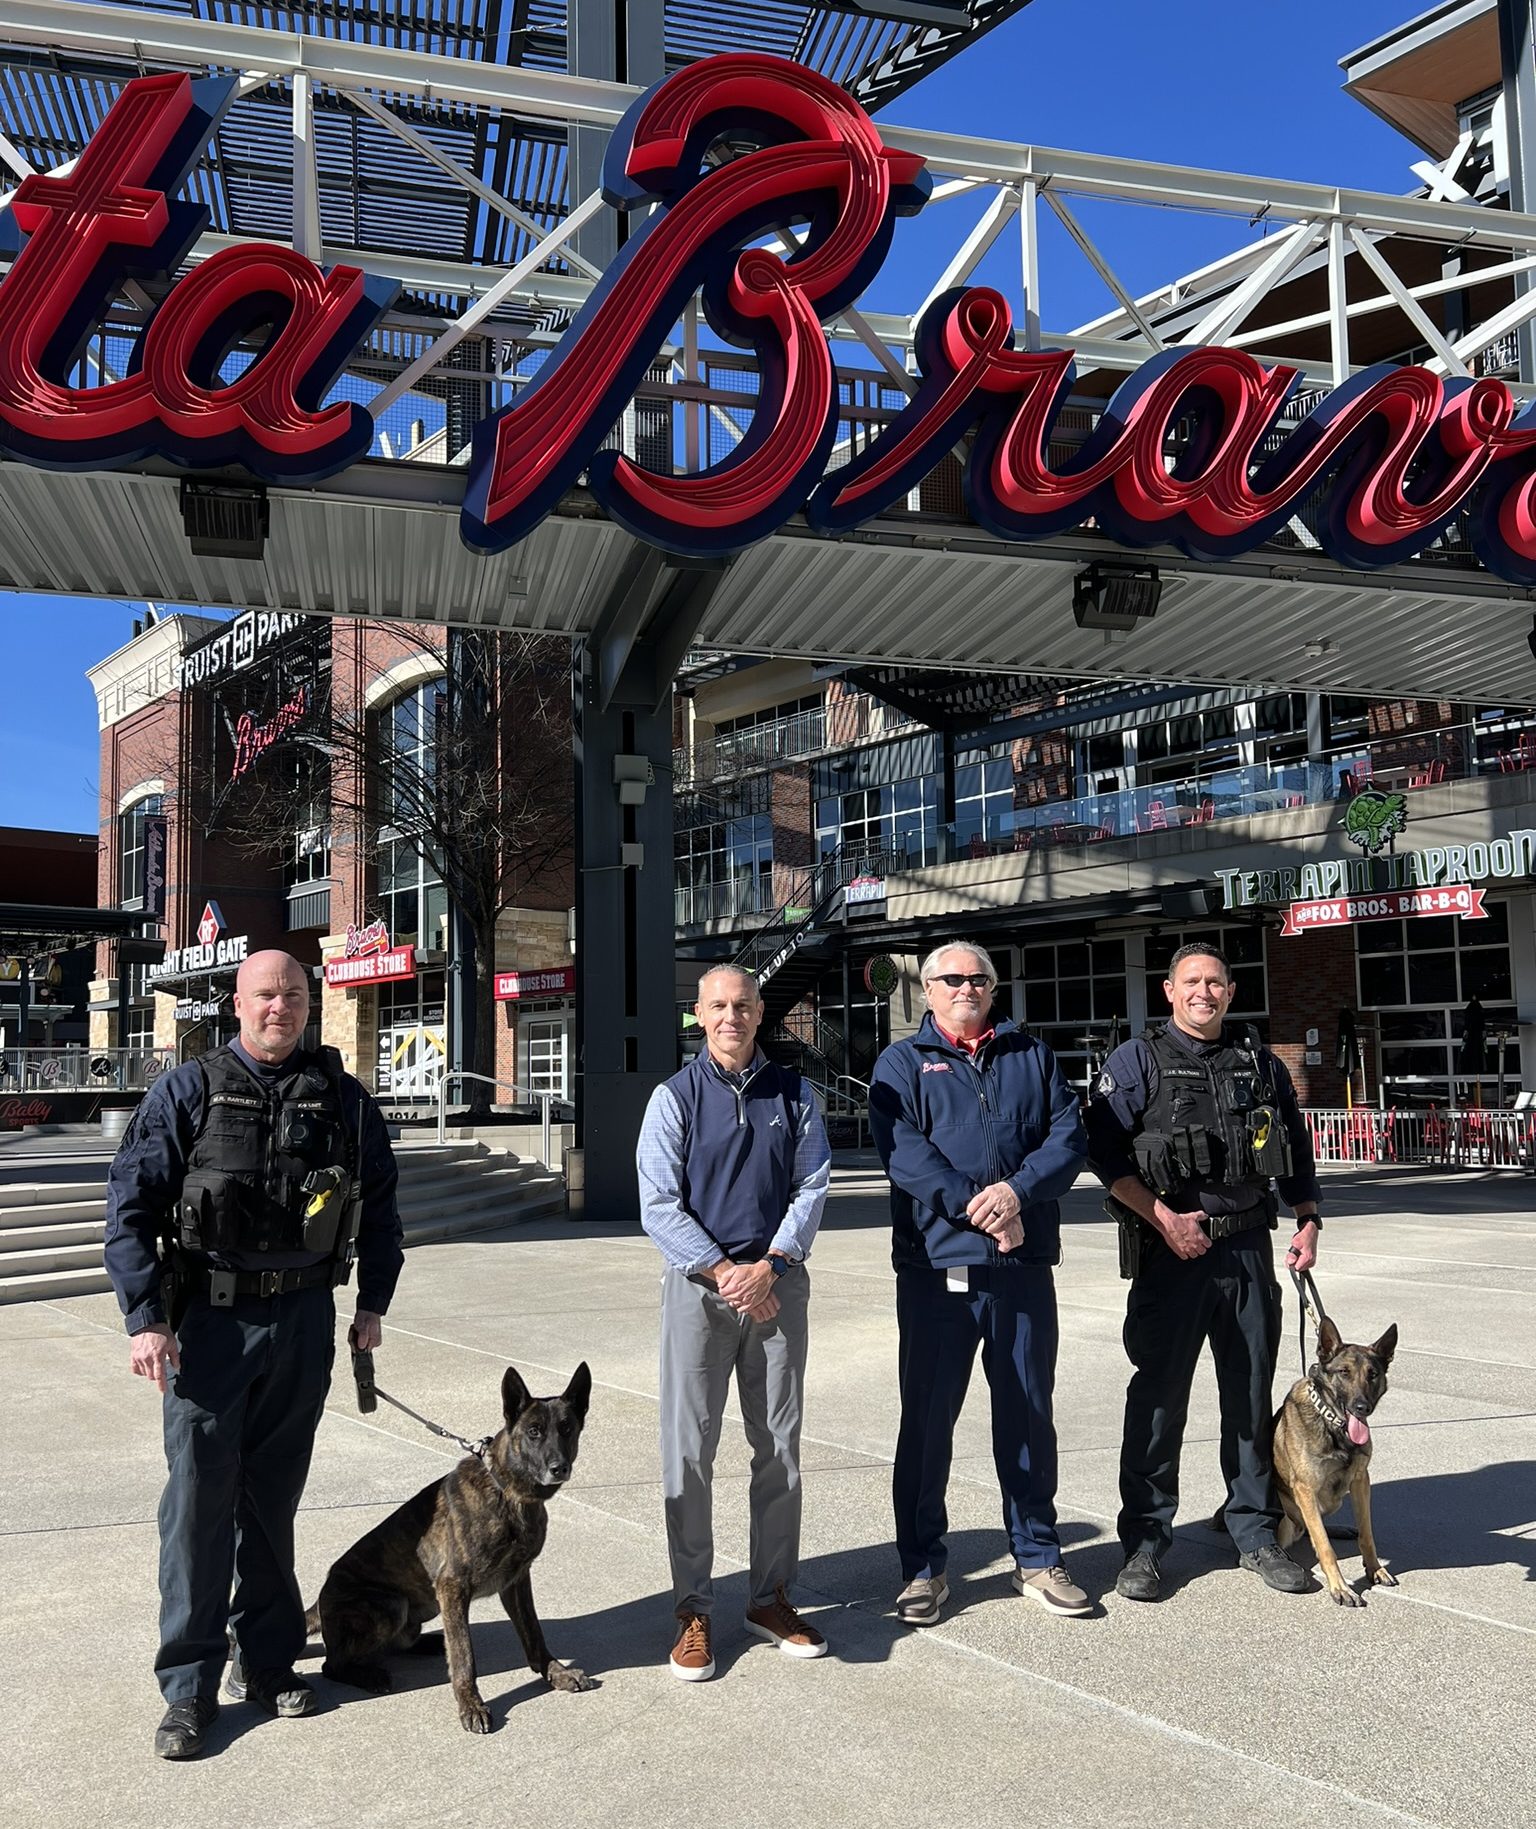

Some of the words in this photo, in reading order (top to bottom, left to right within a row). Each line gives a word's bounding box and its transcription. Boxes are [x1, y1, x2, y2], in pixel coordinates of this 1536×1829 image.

[175, 637, 231, 691] TRUIST
[1214, 857, 1373, 909] TERRAPIN
[1312, 903, 1342, 921] FOX
[1348, 898, 1394, 918] BROS.
[1400, 890, 1470, 912] BAR-B-Q
[202, 919, 215, 942] RF
[181, 943, 215, 971] FIELD
[217, 935, 248, 965] GATE
[329, 958, 375, 982] CLUBHOUSE
[377, 953, 407, 977] STORE
[756, 968, 771, 986] AY
[773, 949, 787, 968] UP
[790, 932, 804, 950] TO
[500, 975, 540, 994] CLUBHOUSE
[541, 972, 566, 989] STORE
[202, 1002, 220, 1017] PARK
[0, 1098, 53, 1121] Bally
